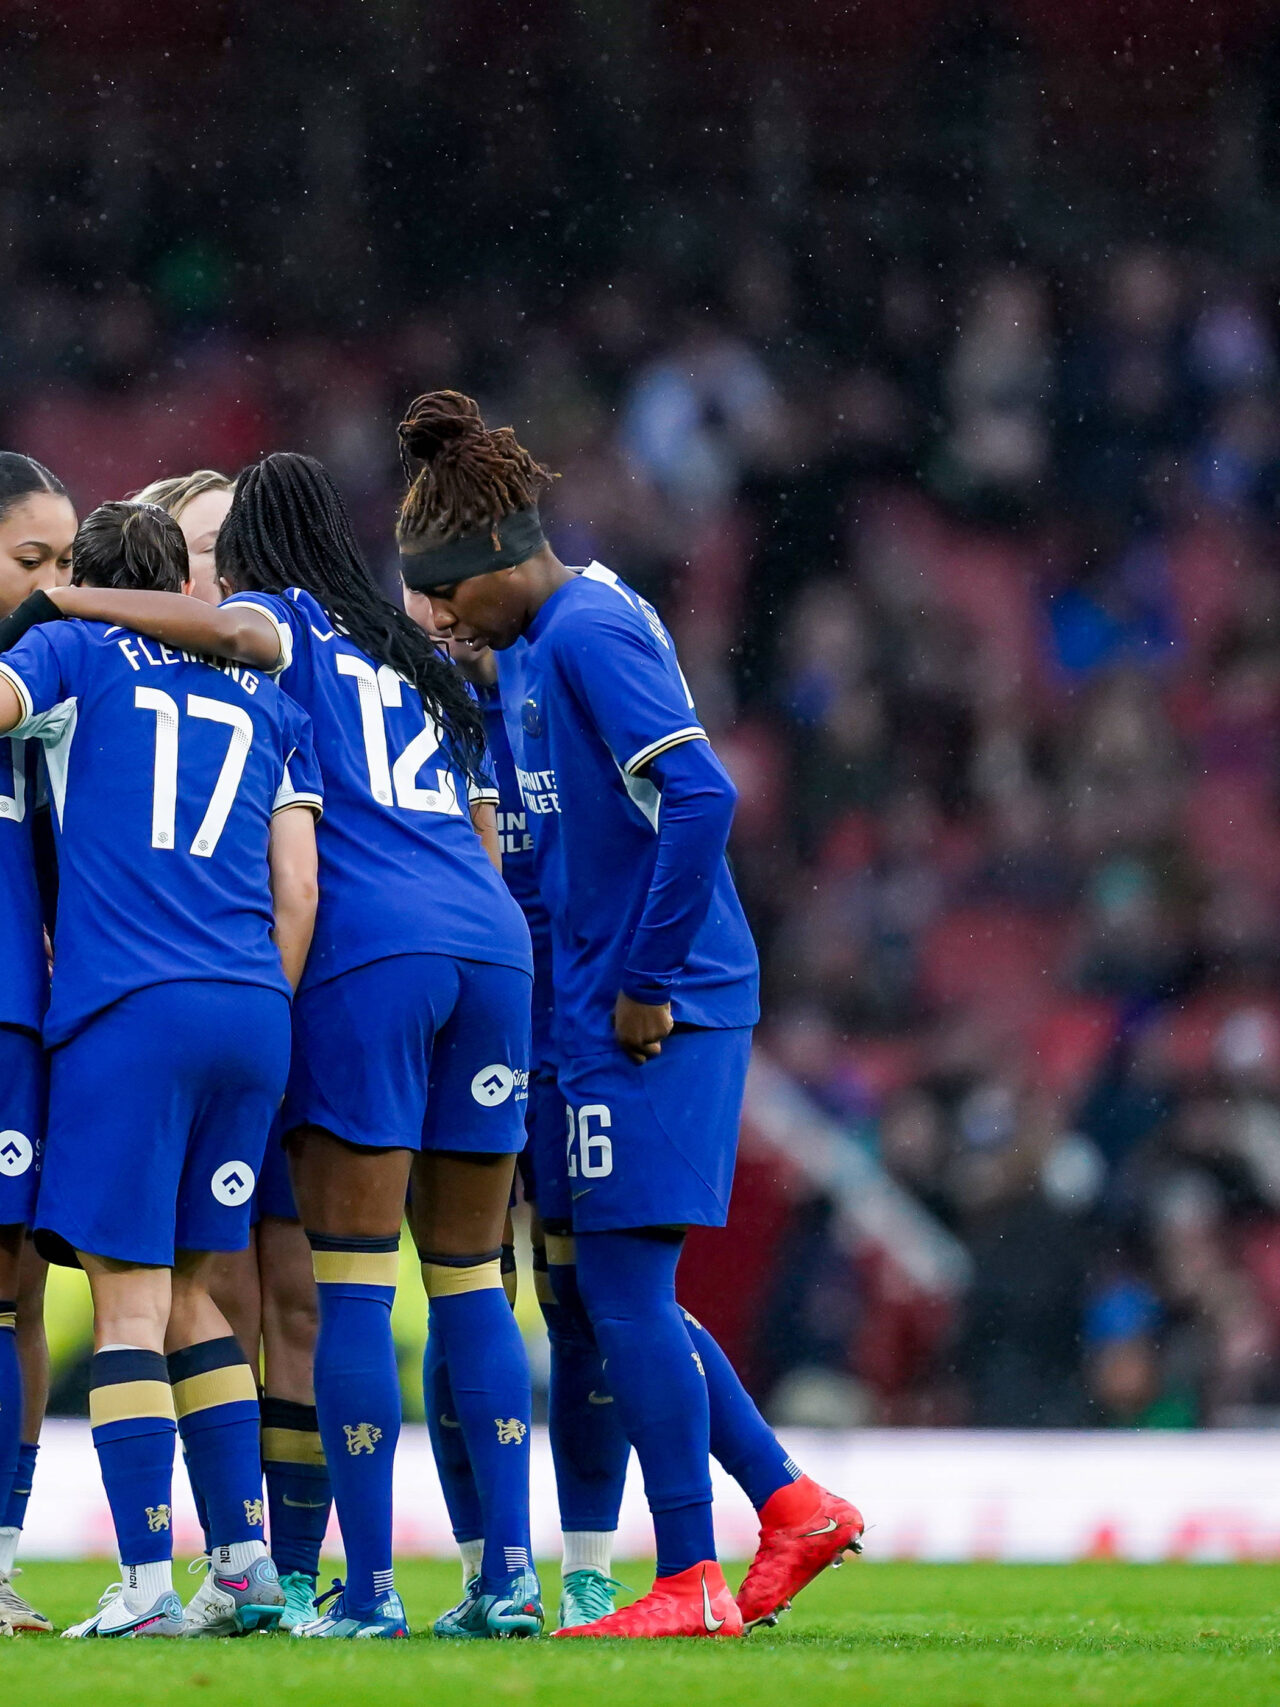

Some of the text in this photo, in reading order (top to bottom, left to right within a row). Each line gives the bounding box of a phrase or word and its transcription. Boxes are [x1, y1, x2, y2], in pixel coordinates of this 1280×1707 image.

[117, 636, 260, 696] FLENG
[134, 685, 254, 858] 17
[335, 652, 464, 816] 12
[566, 1104, 613, 1179] 26
